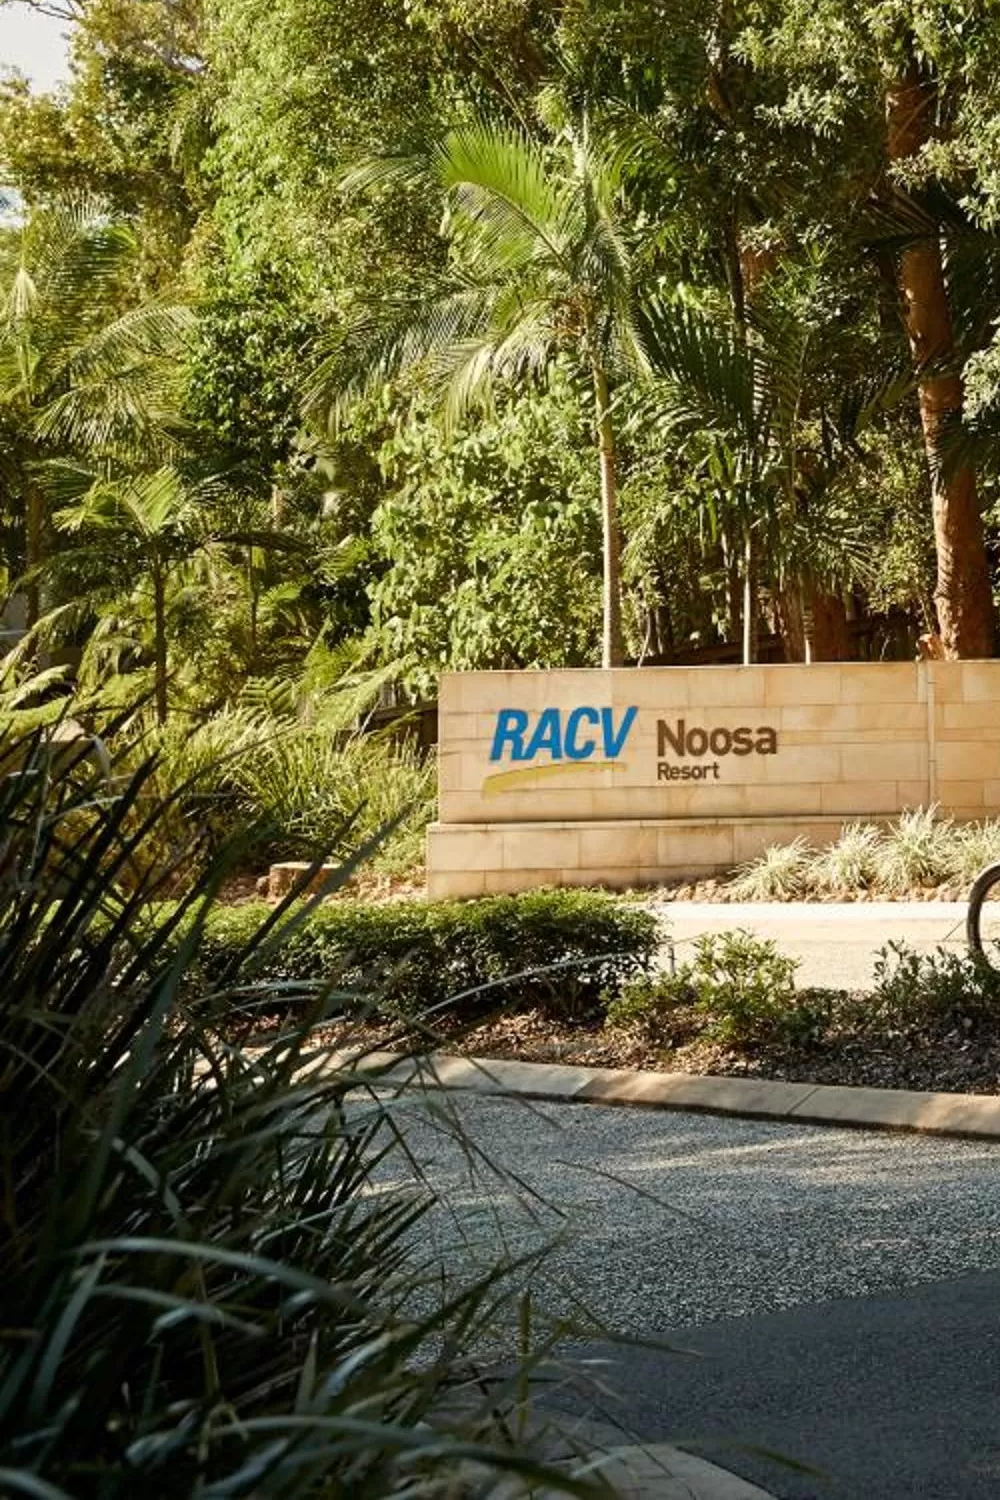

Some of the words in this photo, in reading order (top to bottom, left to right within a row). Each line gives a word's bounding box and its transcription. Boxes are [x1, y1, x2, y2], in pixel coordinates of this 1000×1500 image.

[490, 706, 638, 761] RACV
[656, 718, 779, 757] Noosa
[656, 761, 720, 781] Resort
